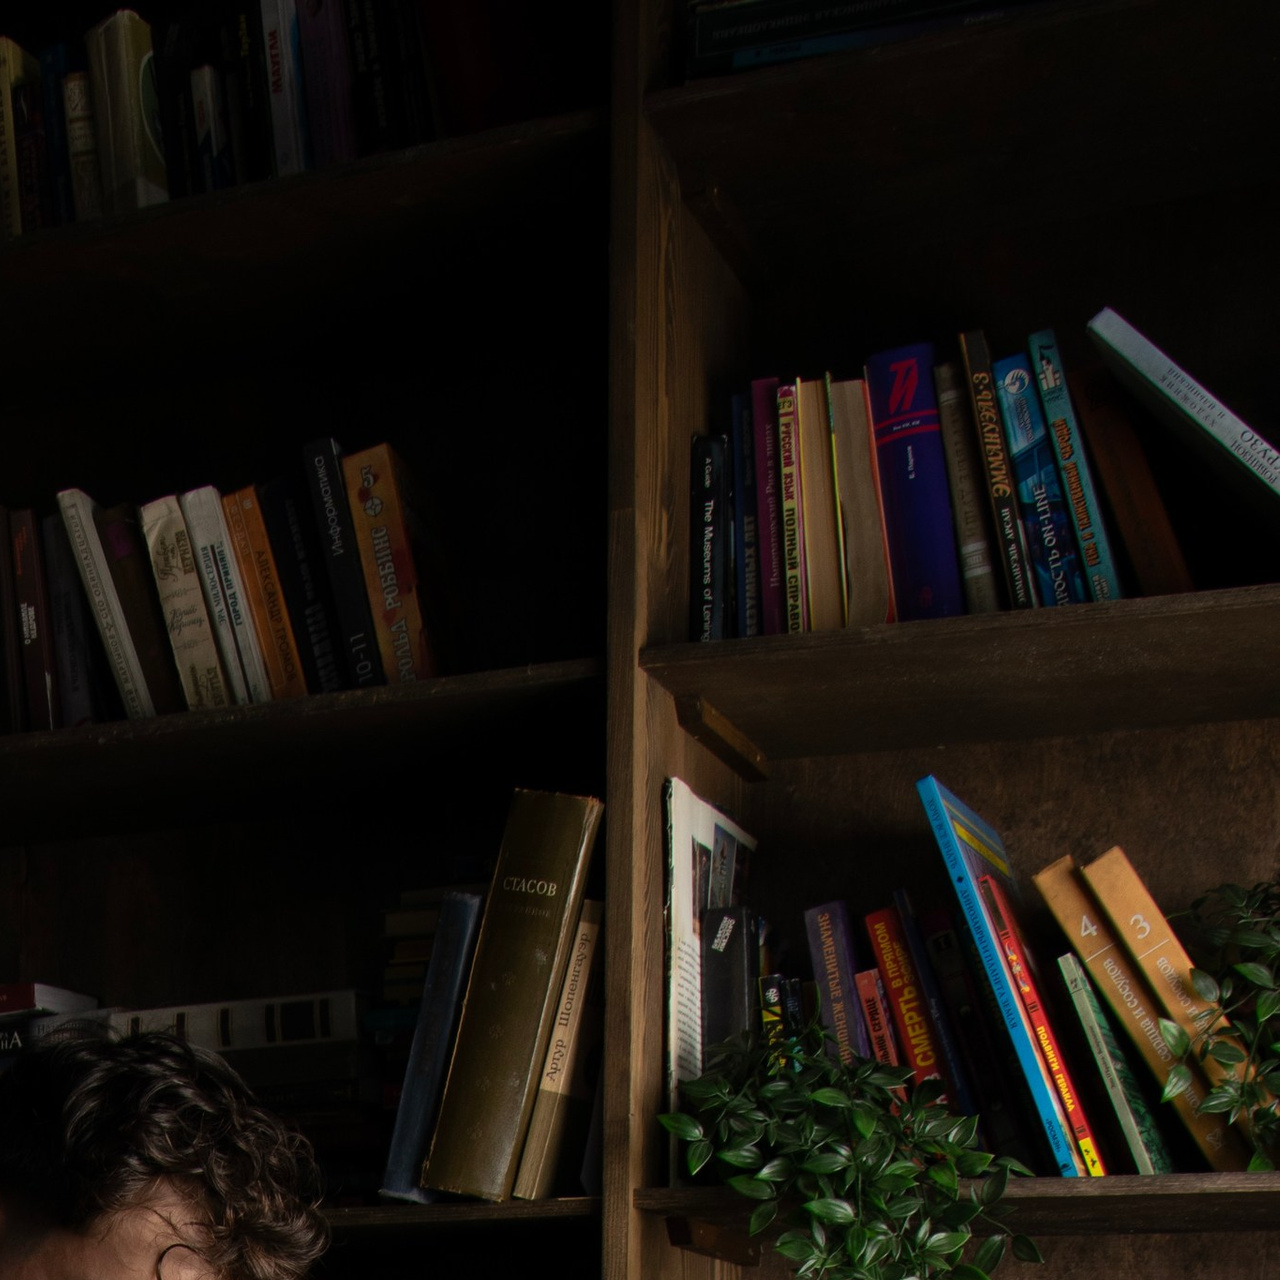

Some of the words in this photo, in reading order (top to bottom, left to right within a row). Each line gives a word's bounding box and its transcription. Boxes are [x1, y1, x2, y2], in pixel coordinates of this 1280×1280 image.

[1158, 373, 1218, 428] ХУДОЖНИК
[779, 422, 794, 466] РУССКИЙ
[1049, 416, 1077, 461] ЧАРОДЕЙ
[1229, 438, 1278, 486] РОБИНЗОН
[703, 465, 711, 487] Guide
[783, 472, 795, 500] ЯЗЫК
[1060, 461, 1092, 531] ТАИНСТВЕННЫЙ
[313, 454, 346, 556] Информатика
[703, 500, 713, 522] The
[743, 514, 755, 542] ЛЕТ
[1000, 507, 1015, 540] АРСАН
[1029, 484, 1059, 547] ON-LINE
[701, 526, 714, 583] Museums
[783, 508, 800, 570] ПОЛНЫЙ
[200, 545, 222, 607] МИЛОСЕРДИЯ
[369, 525, 402, 610] РОББИНС
[228, 591, 242, 625] ГОРОД
[252, 548, 284, 624] АЛЕКСАНДР
[273, 627, 300, 681] ГРОМОВ
[700, 604, 712, 641] Lening
[787, 575, 801, 632] СПРАВО
[349, 632, 374, 684] 10-11
[387, 618, 417, 683] РОЛЬД
[502, 876, 557, 896] СТАСОВ
[924, 797, 943, 824] ХОЧУ
[940, 840, 960, 869] ЗНАТЬ
[956, 888, 989, 947] ДИНОЗАВРЫ
[981, 953, 1008, 998] ПЛАНЕТА
[999, 997, 1019, 1030] ЗЕМЛЯ
[1081, 914, 1098, 937] 4
[1130, 914, 1151, 939] 3
[815, 912, 844, 999] ЗНАМЕНИТЫЕ
[872, 921, 899, 979] ПРЯМОМ
[892, 939, 914, 984] ЭФИРЕ
[544, 1038, 568, 1082] Артур
[557, 931, 591, 1028] Шопенгауэр
[1100, 956, 1138, 1010] сосудов
[1154, 954, 1194, 1008] сосудов
[864, 995, 885, 1032] СЕРДЦЕ
[895, 984, 936, 1068] СМЕРТЬ
[1138, 1016, 1172, 1064] сердца
[1034, 1025, 1062, 1071] ПОДВИГИ
[1053, 1073, 1077, 1111] ГЕРАКЛА
